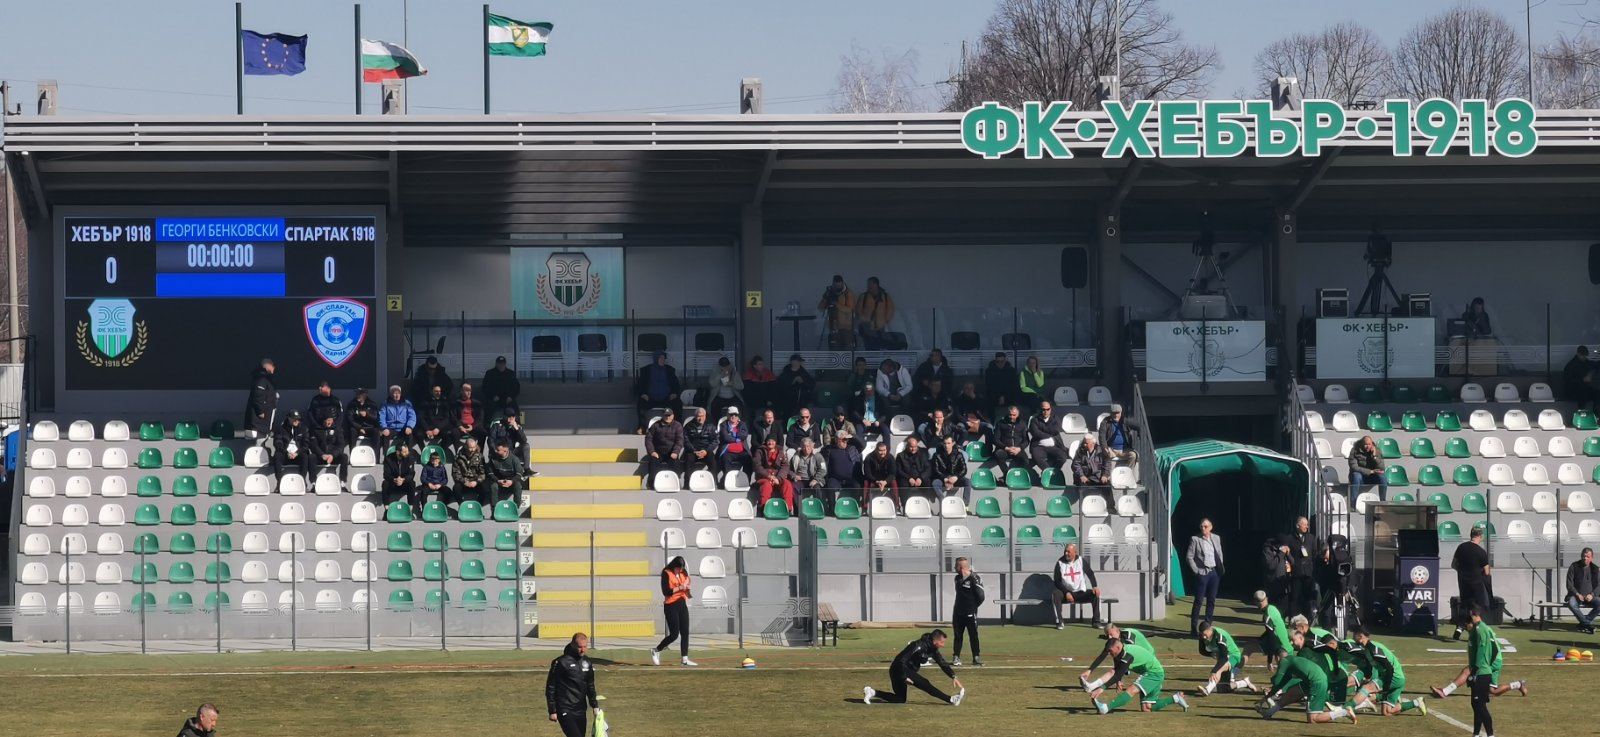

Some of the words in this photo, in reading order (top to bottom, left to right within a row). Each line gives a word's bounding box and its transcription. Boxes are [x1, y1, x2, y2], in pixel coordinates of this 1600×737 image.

[961, 101, 1074, 159] ФК
[1101, 100, 1346, 158] ХЕБЪР
[1384, 98, 1537, 157] 1918
[71, 226, 122, 242] ХЕБЪР
[125, 226, 151, 242] 1918
[162, 224, 206, 237] ГЕОРГИ
[208, 224, 279, 237] БЕНКОВСКИ
[285, 227, 349, 241] СПАРТАК
[352, 226, 375, 241] 1918
[187, 244, 254, 267] 00:00:00
[105, 257, 117, 284] 0
[324, 256, 335, 283] 0
[391, 300, 398, 310] 2
[750, 296, 757, 306] 2
[1173, 326, 1190, 336] ФК
[1343, 323, 1360, 332] ФК
[1406, 590, 1433, 600] VAR
